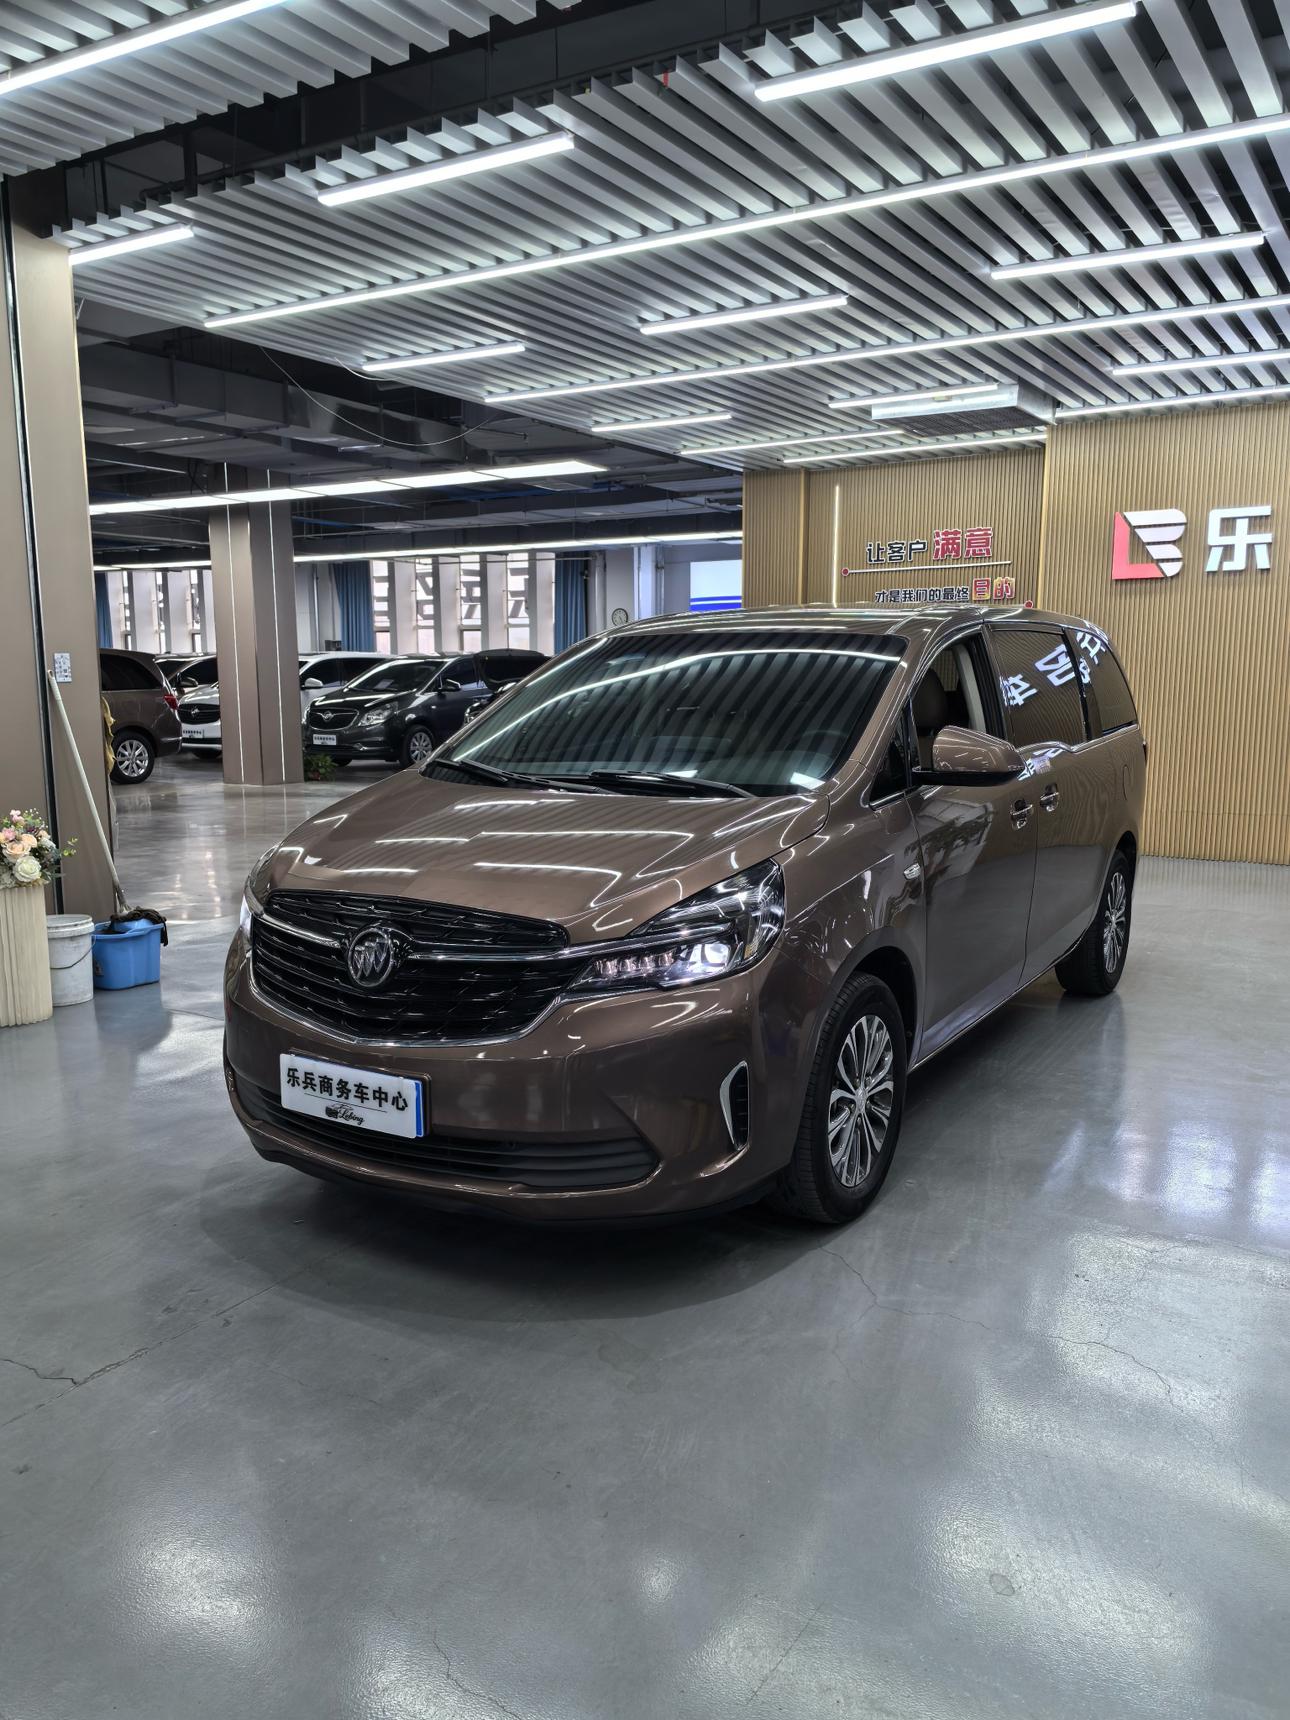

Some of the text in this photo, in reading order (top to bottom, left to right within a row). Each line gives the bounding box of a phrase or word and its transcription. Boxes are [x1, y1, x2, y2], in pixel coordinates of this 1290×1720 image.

[1205, 505, 1273, 572] 乐
[286, 1067, 409, 1111] 乐兵商务车中心
